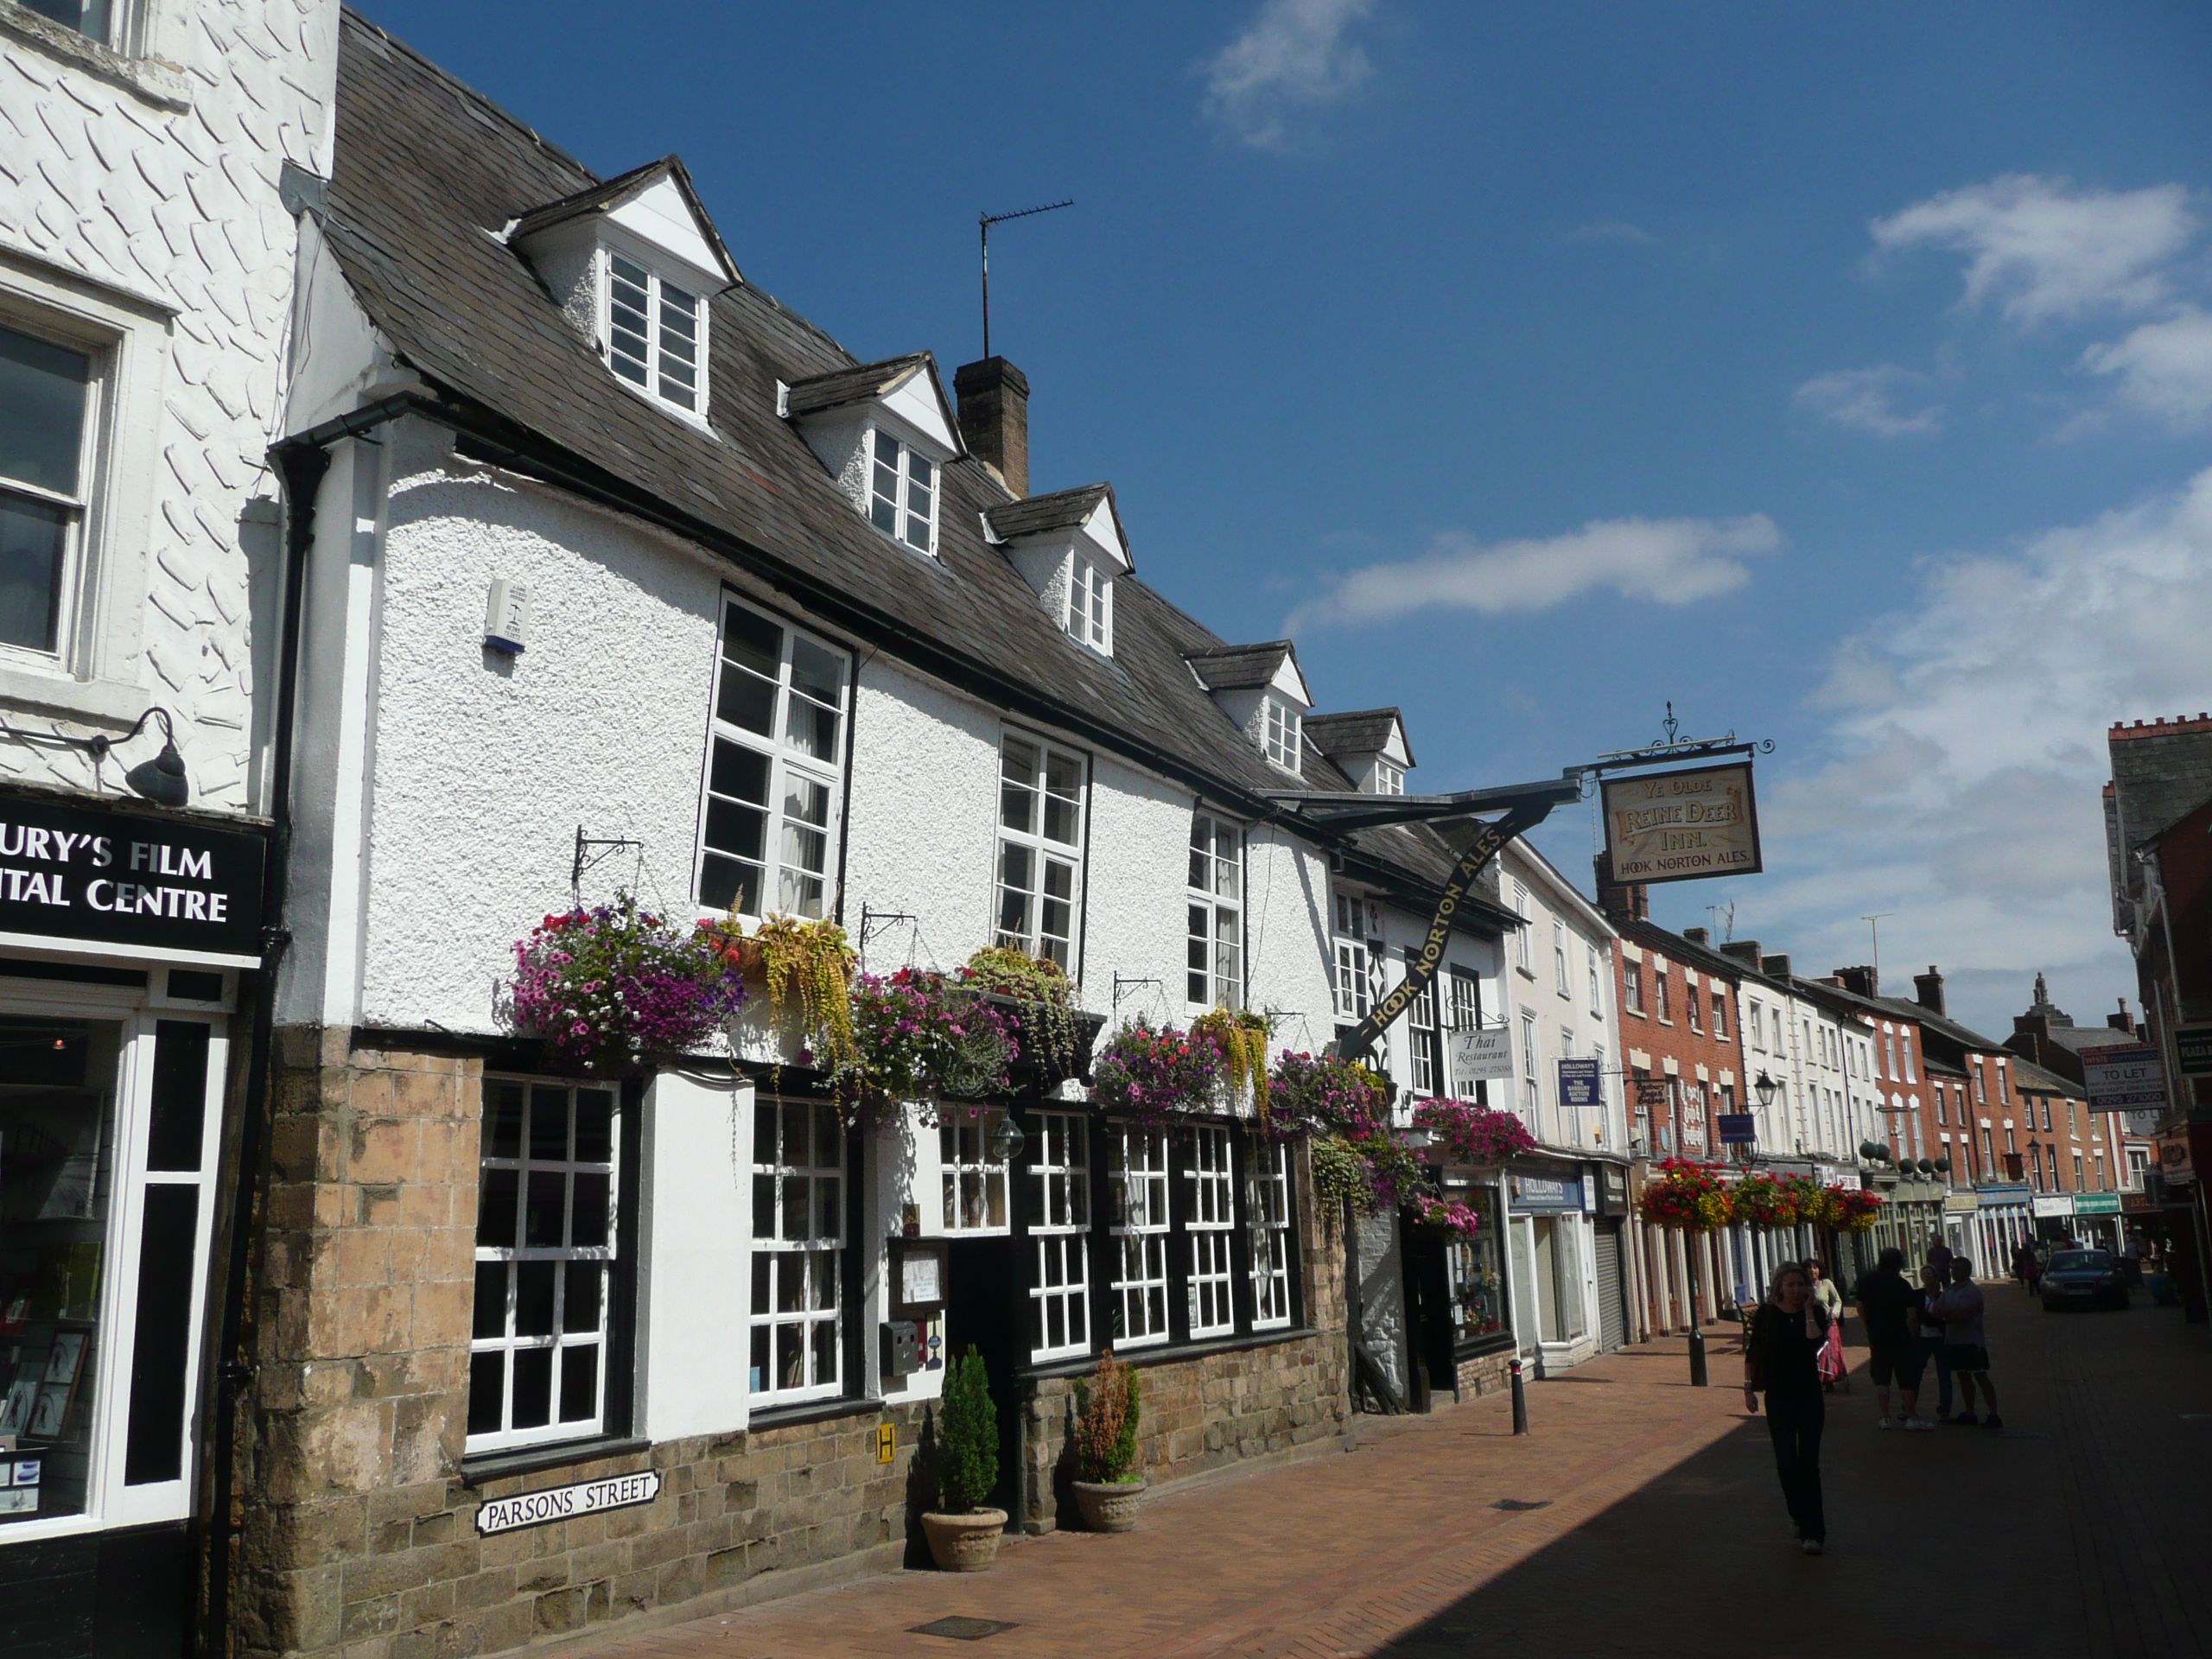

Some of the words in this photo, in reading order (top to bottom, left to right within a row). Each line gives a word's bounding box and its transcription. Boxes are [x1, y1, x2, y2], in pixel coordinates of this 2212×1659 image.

[1625, 805, 1683, 833] REINE
[1685, 800, 1738, 823] DEER
[0, 823, 112, 868] URY'S
[130, 841, 213, 880] FILM
[1621, 861, 1653, 875] HOOK
[1657, 855, 1712, 871] NORTON
[1717, 850, 1751, 865] ALES.
[86, 879, 228, 923] CENTRE
[1371, 977, 1419, 1028] HOOK
[1414, 882, 1464, 977] NORTON
[1456, 1050, 1508, 1065] Restaurant
[1463, 1033, 1496, 1050] Thai
[2102, 1070, 2120, 1080] TO
[2124, 1068, 2146, 1079] LET
[2131, 1109, 2146, 1120] TO
[880, 1427, 893, 1459] H
[486, 1491, 573, 1529] PARSONS
[586, 1476, 651, 1509] STREET
